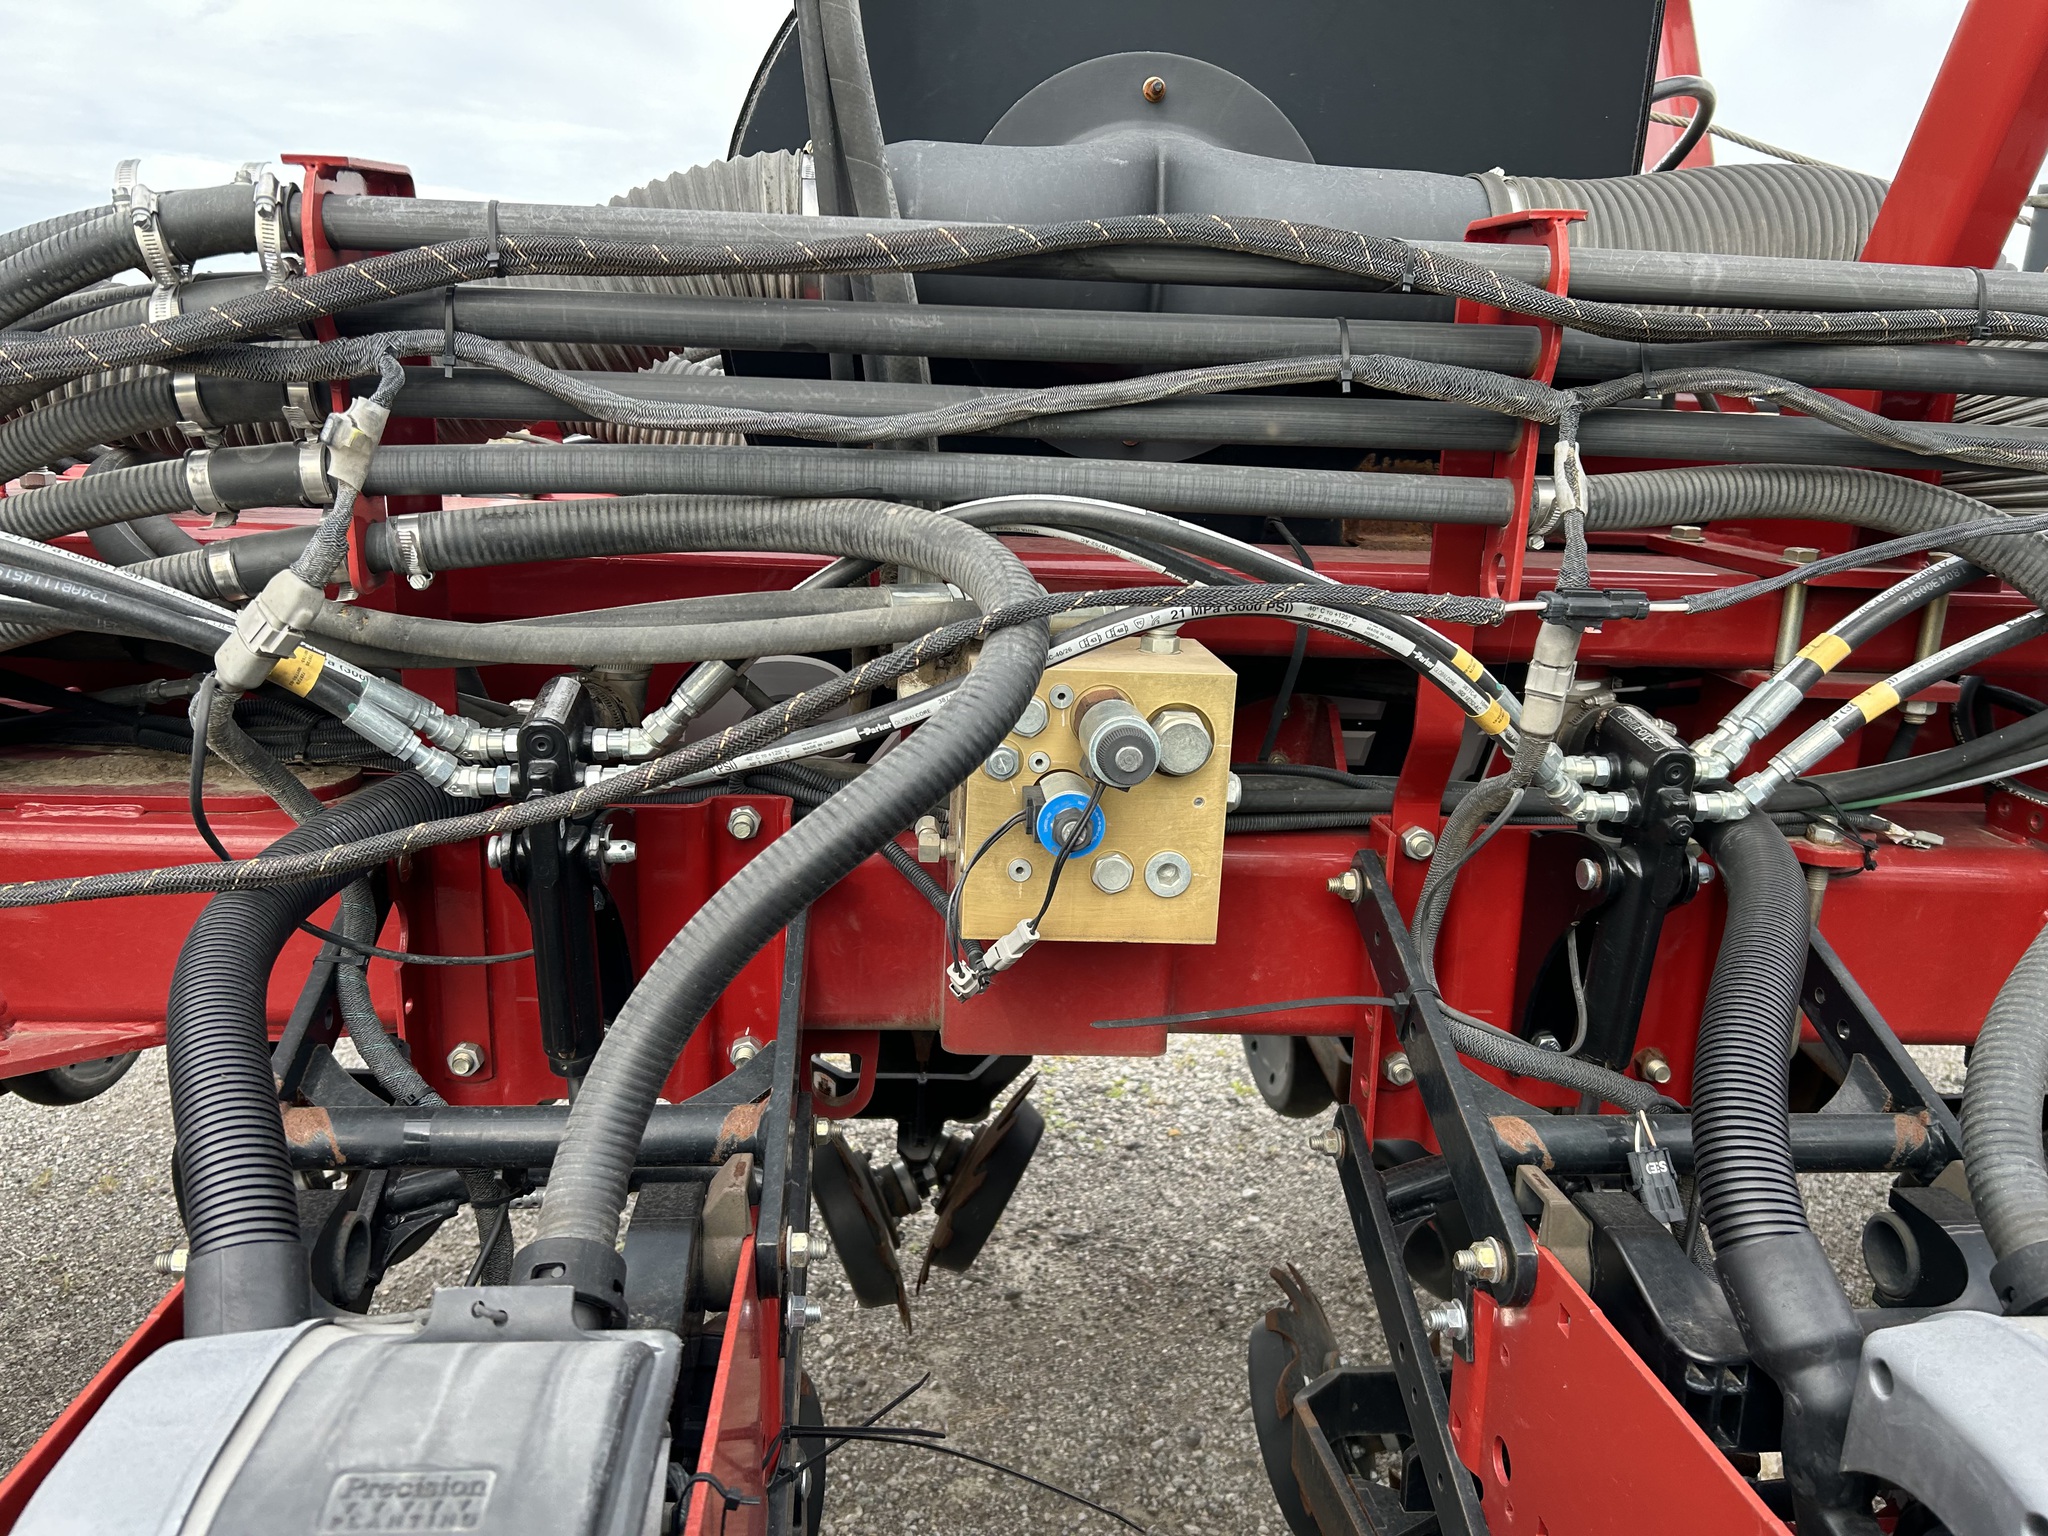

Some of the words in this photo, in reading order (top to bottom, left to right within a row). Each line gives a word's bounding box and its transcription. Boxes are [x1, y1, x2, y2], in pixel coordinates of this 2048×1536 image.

[1899, 566, 1967, 605] 1804300916
[1170, 608, 1186, 620] 21
[1190, 604, 1220, 617] MPa
[1225, 602, 1262, 613] (3000
[1265, 602, 1295, 614] PSI)
[1412, 650, 1434, 669] Parker
[860, 721, 892, 737] Parker
[894, 708, 932, 726] GLOBALCORE
[341, 1475, 488, 1500] Precision
